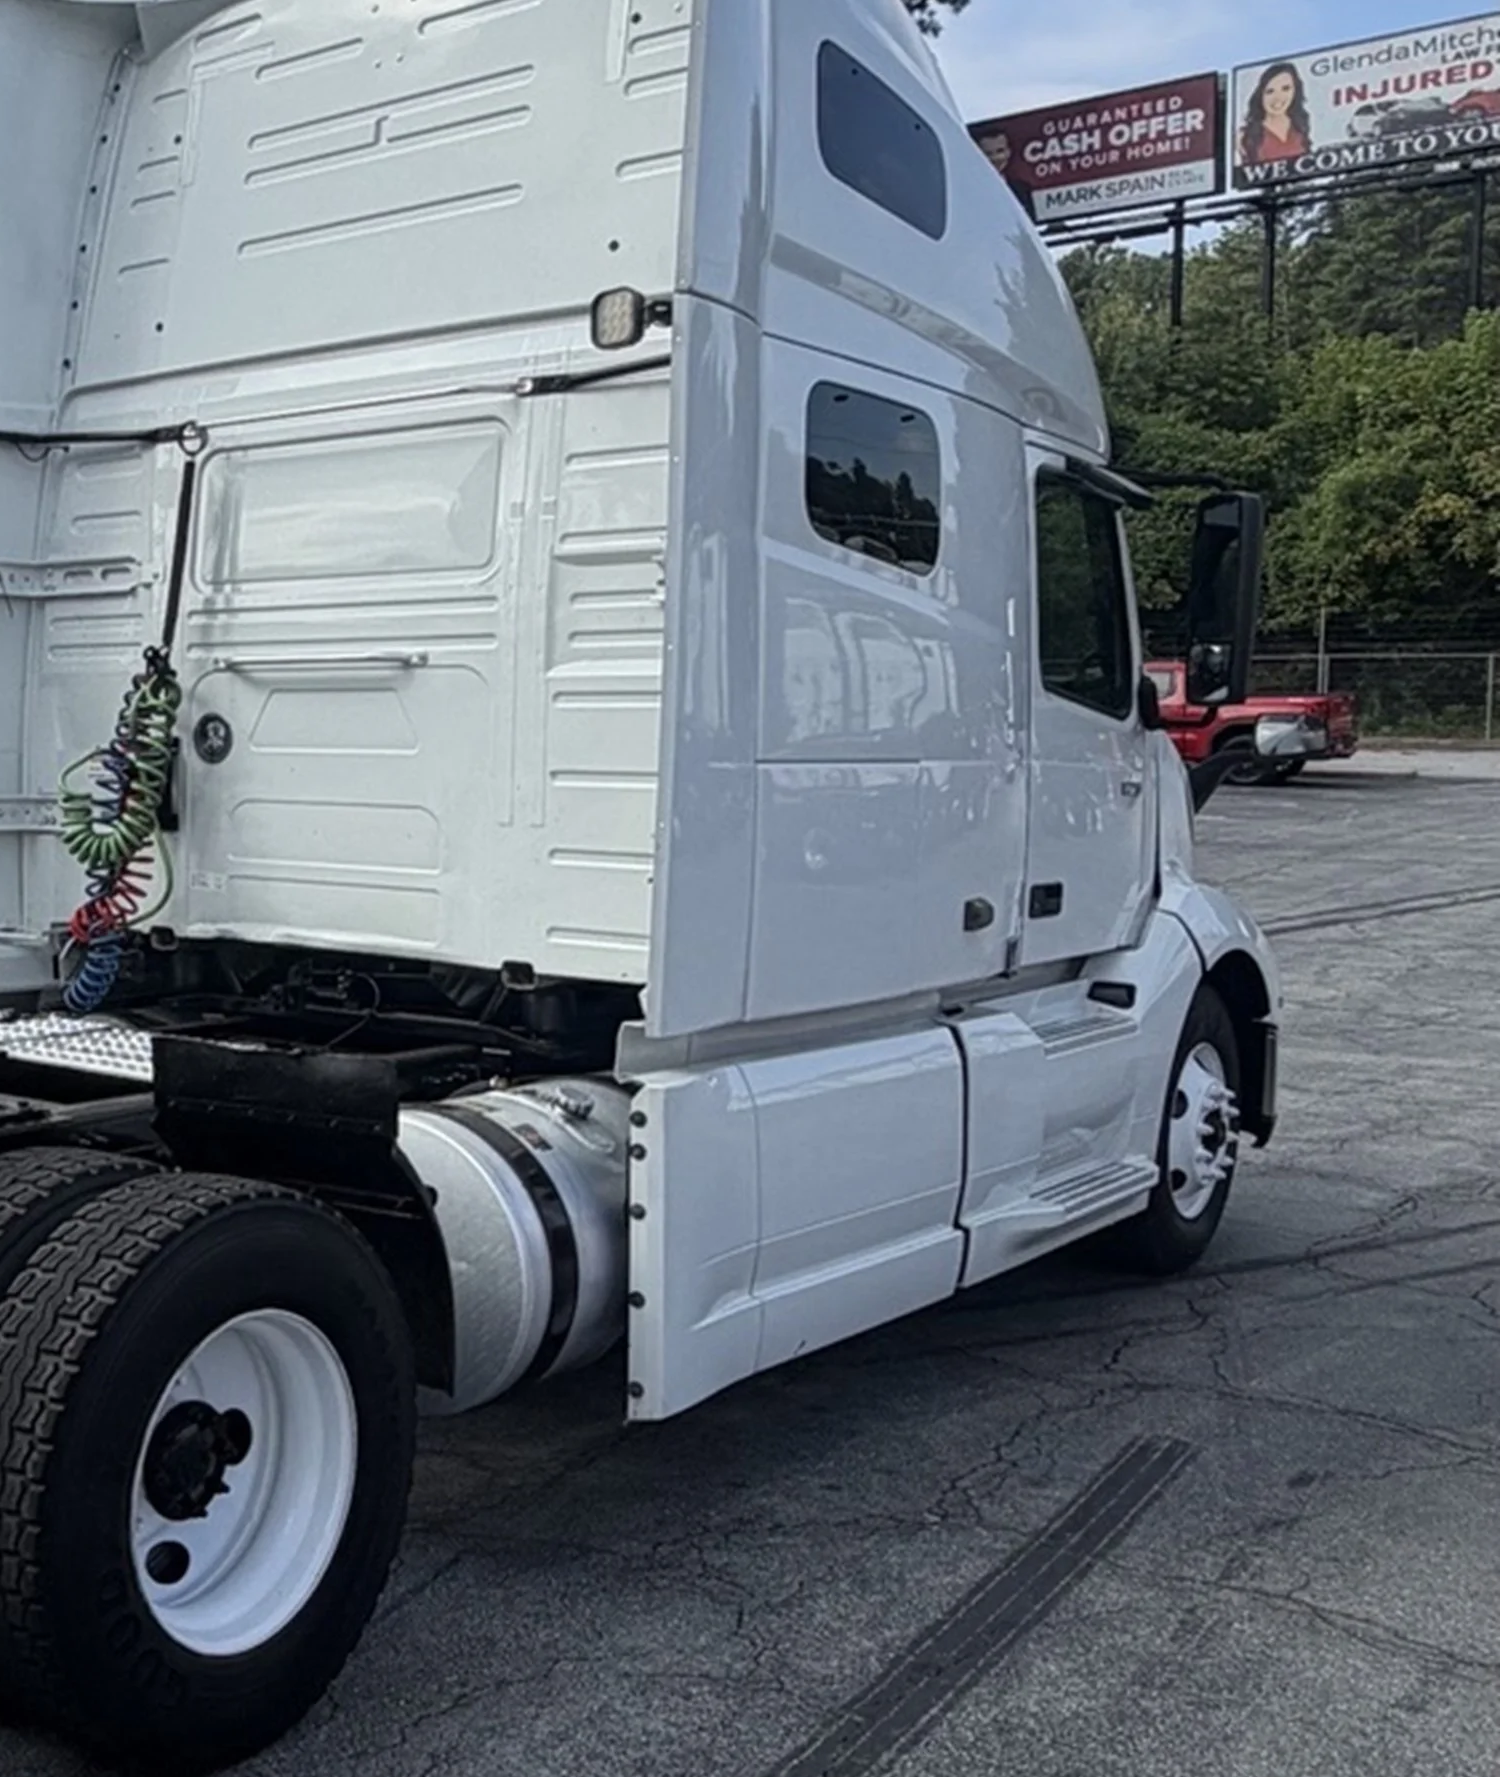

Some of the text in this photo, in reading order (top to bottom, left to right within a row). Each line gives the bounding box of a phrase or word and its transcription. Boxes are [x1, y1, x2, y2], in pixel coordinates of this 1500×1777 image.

[1309, 26, 1500, 77] GlendaMitch
[1440, 46, 1481, 64] LAW
[1333, 59, 1500, 107] INJURED
[1023, 108, 1205, 163] CASH OFFER
[1042, 95, 1184, 136] GUARANTEED
[1035, 137, 1191, 177] ON YOUR HOME!
[1242, 159, 1289, 183] WE
[1294, 141, 1387, 174] COME
[1391, 133, 1438, 157] TO
[1045, 185, 1103, 209] MARK
[1105, 174, 1166, 199] SPAIN
